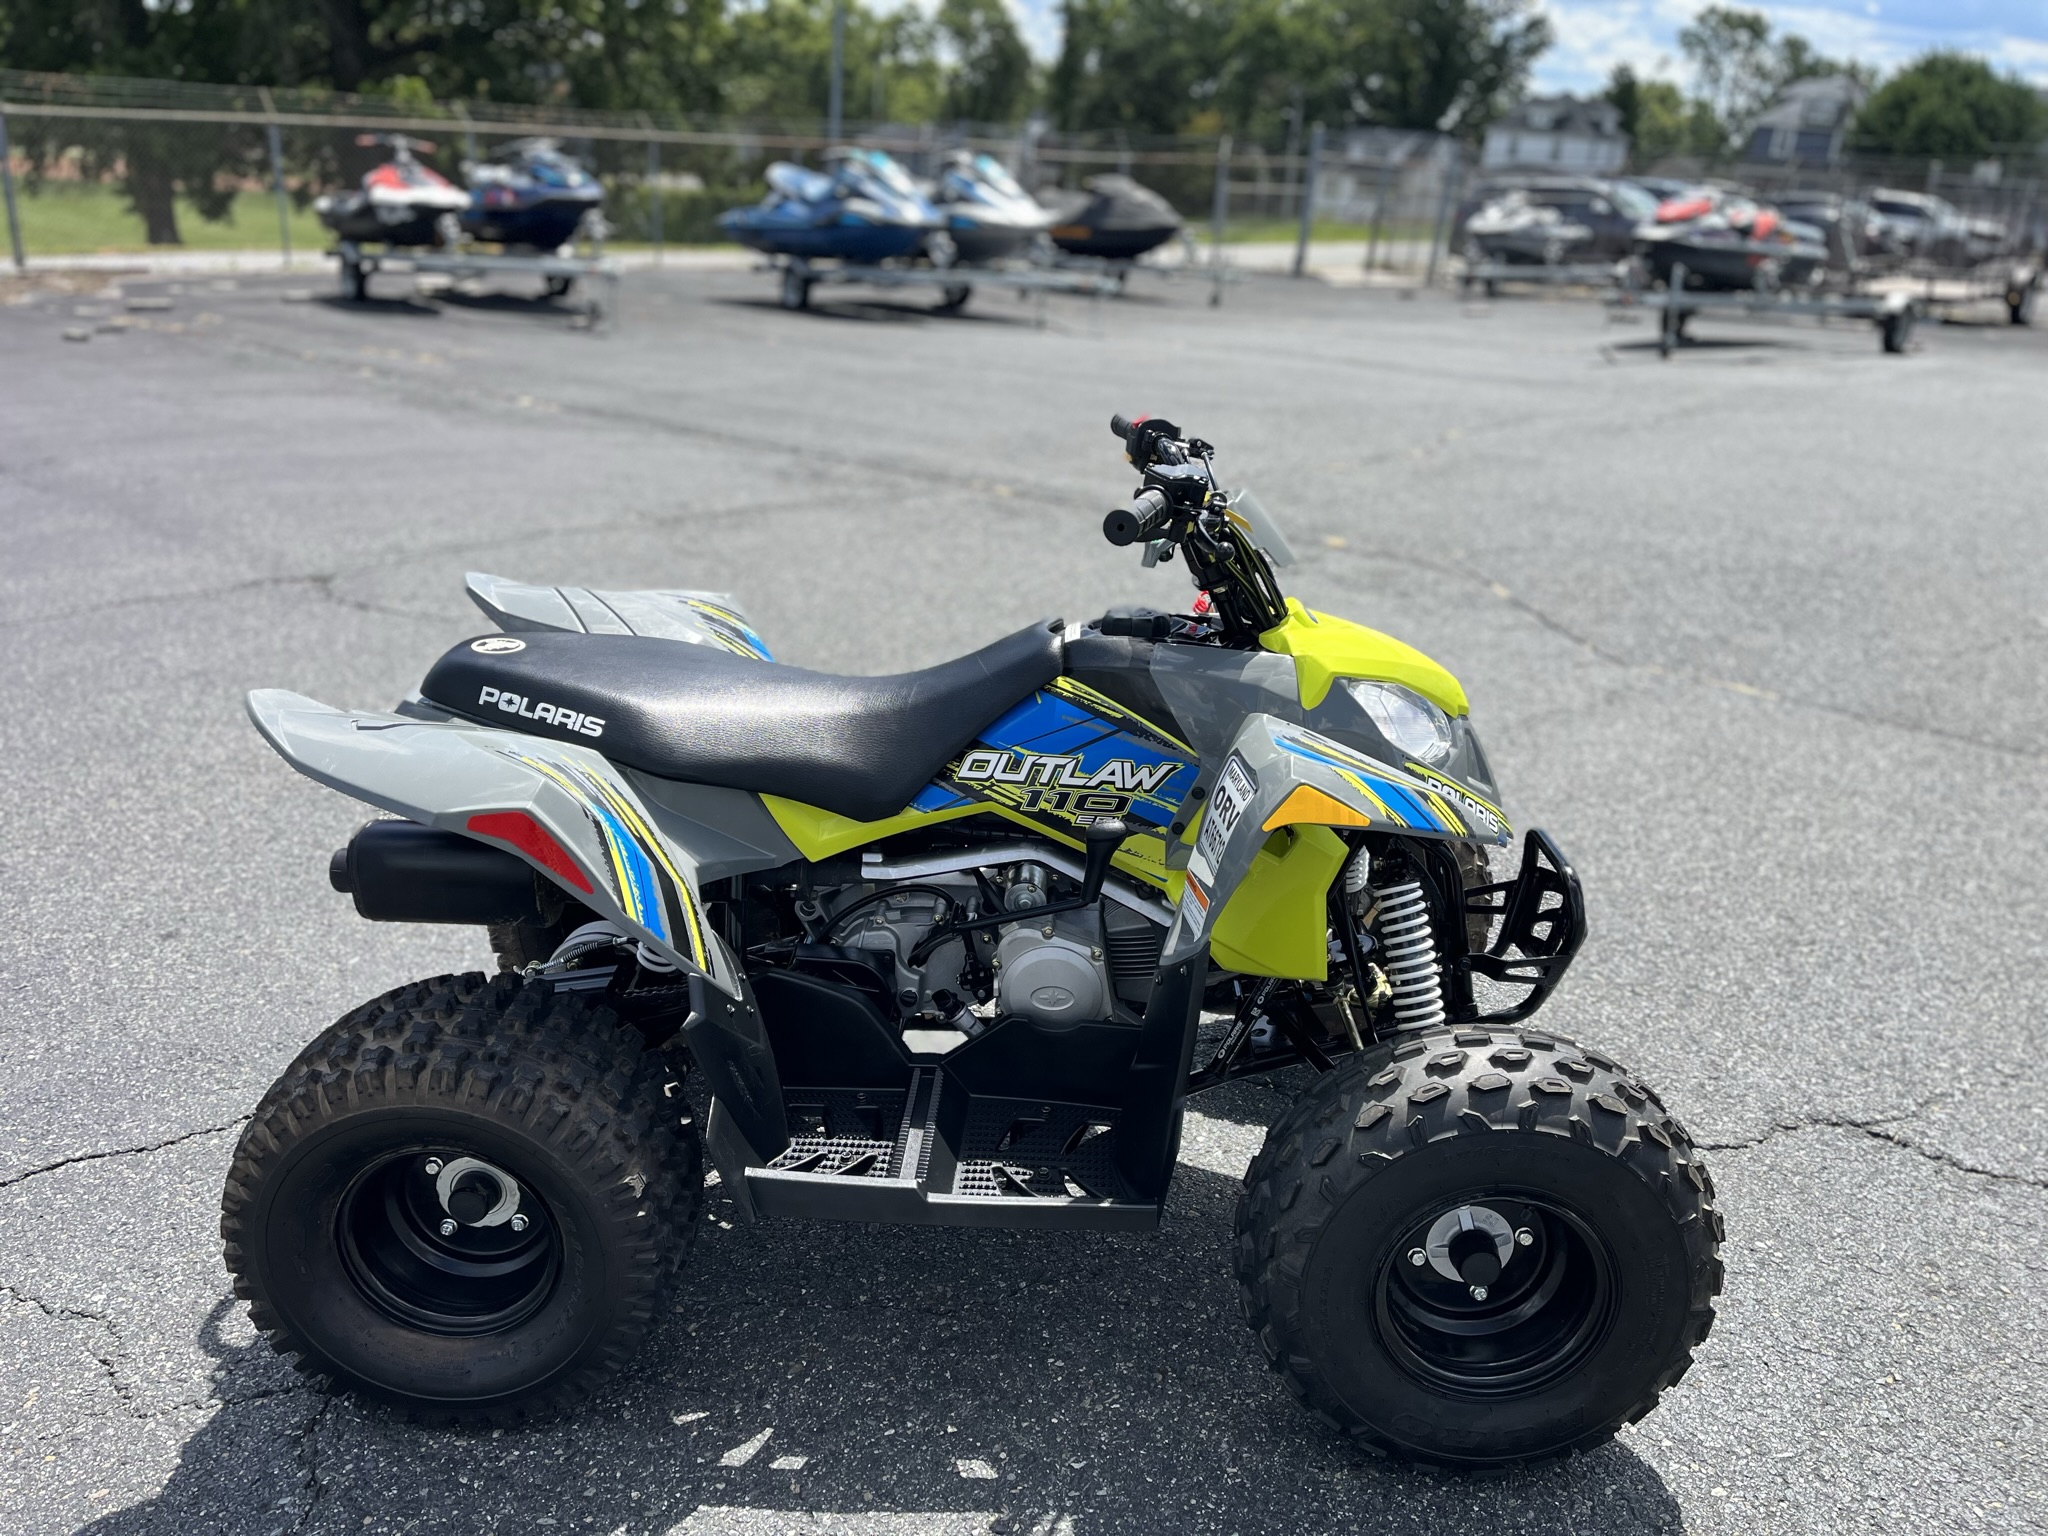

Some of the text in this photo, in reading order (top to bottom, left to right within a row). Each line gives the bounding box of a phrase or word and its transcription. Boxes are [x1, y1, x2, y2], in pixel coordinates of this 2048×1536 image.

[478, 685, 606, 737] POLARIS
[957, 751, 1177, 791] OUTLAW
[1227, 765, 1251, 802] MARYLAND
[1020, 788, 1134, 815] 110
[1213, 785, 1241, 832] ORV
[1427, 777, 1499, 834] POLARIS
